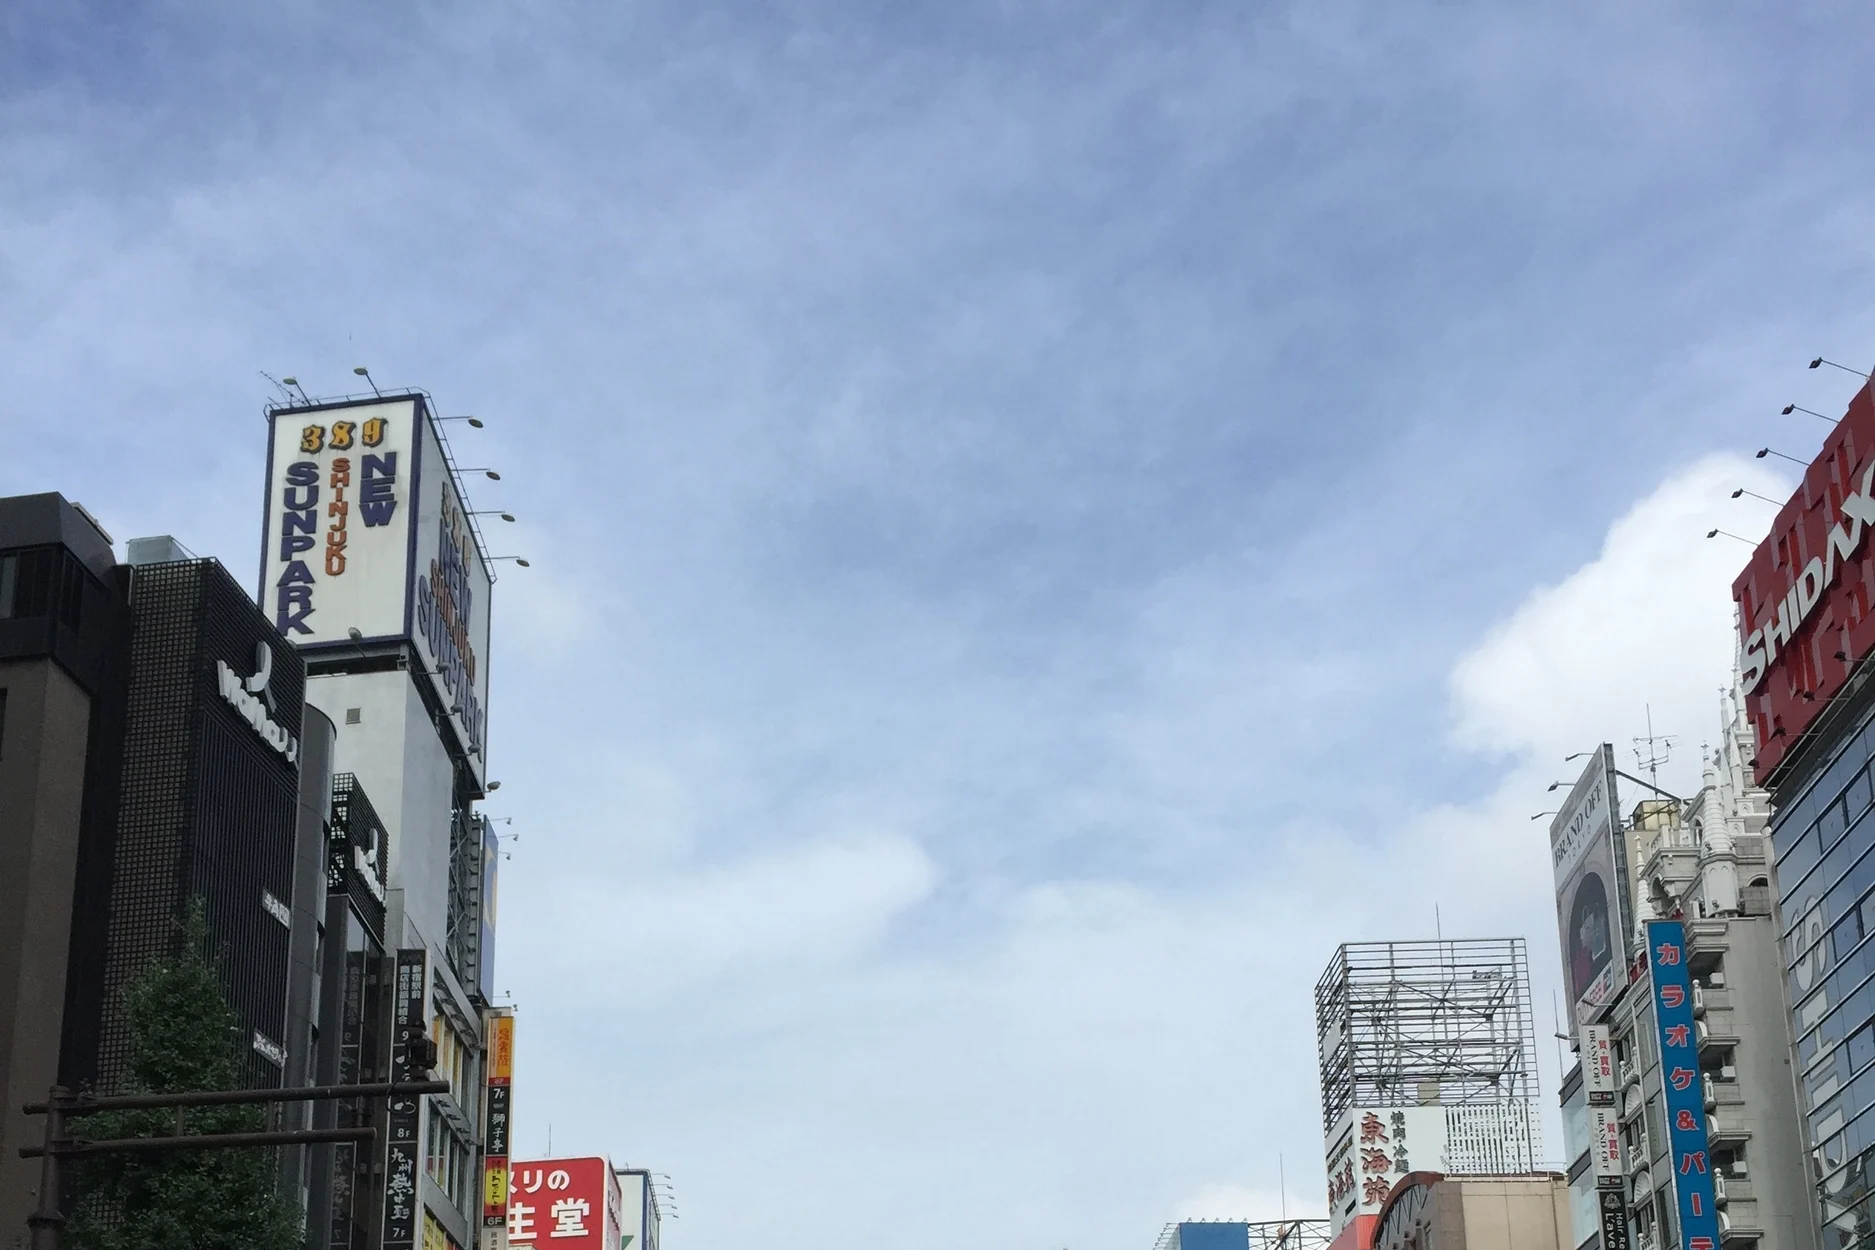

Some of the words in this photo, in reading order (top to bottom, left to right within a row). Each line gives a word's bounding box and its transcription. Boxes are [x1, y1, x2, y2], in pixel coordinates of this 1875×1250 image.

[300, 417, 388, 454] 389
[359, 452, 398, 527] NEW
[325, 457, 350, 577] SHINJUKU
[276, 461, 320, 636] SUNPARK
[1554, 815, 1584, 869] BRAND
[1584, 780, 1603, 821] OFF
[1589, 1030, 1599, 1065] BRAND
[397, 1128, 411, 1138] 8F
[1597, 1112, 1607, 1148] BRAND
[392, 1228, 406, 1238] 7F
[487, 1217, 502, 1226] 6F
[1615, 1212, 1624, 1235] Hair
